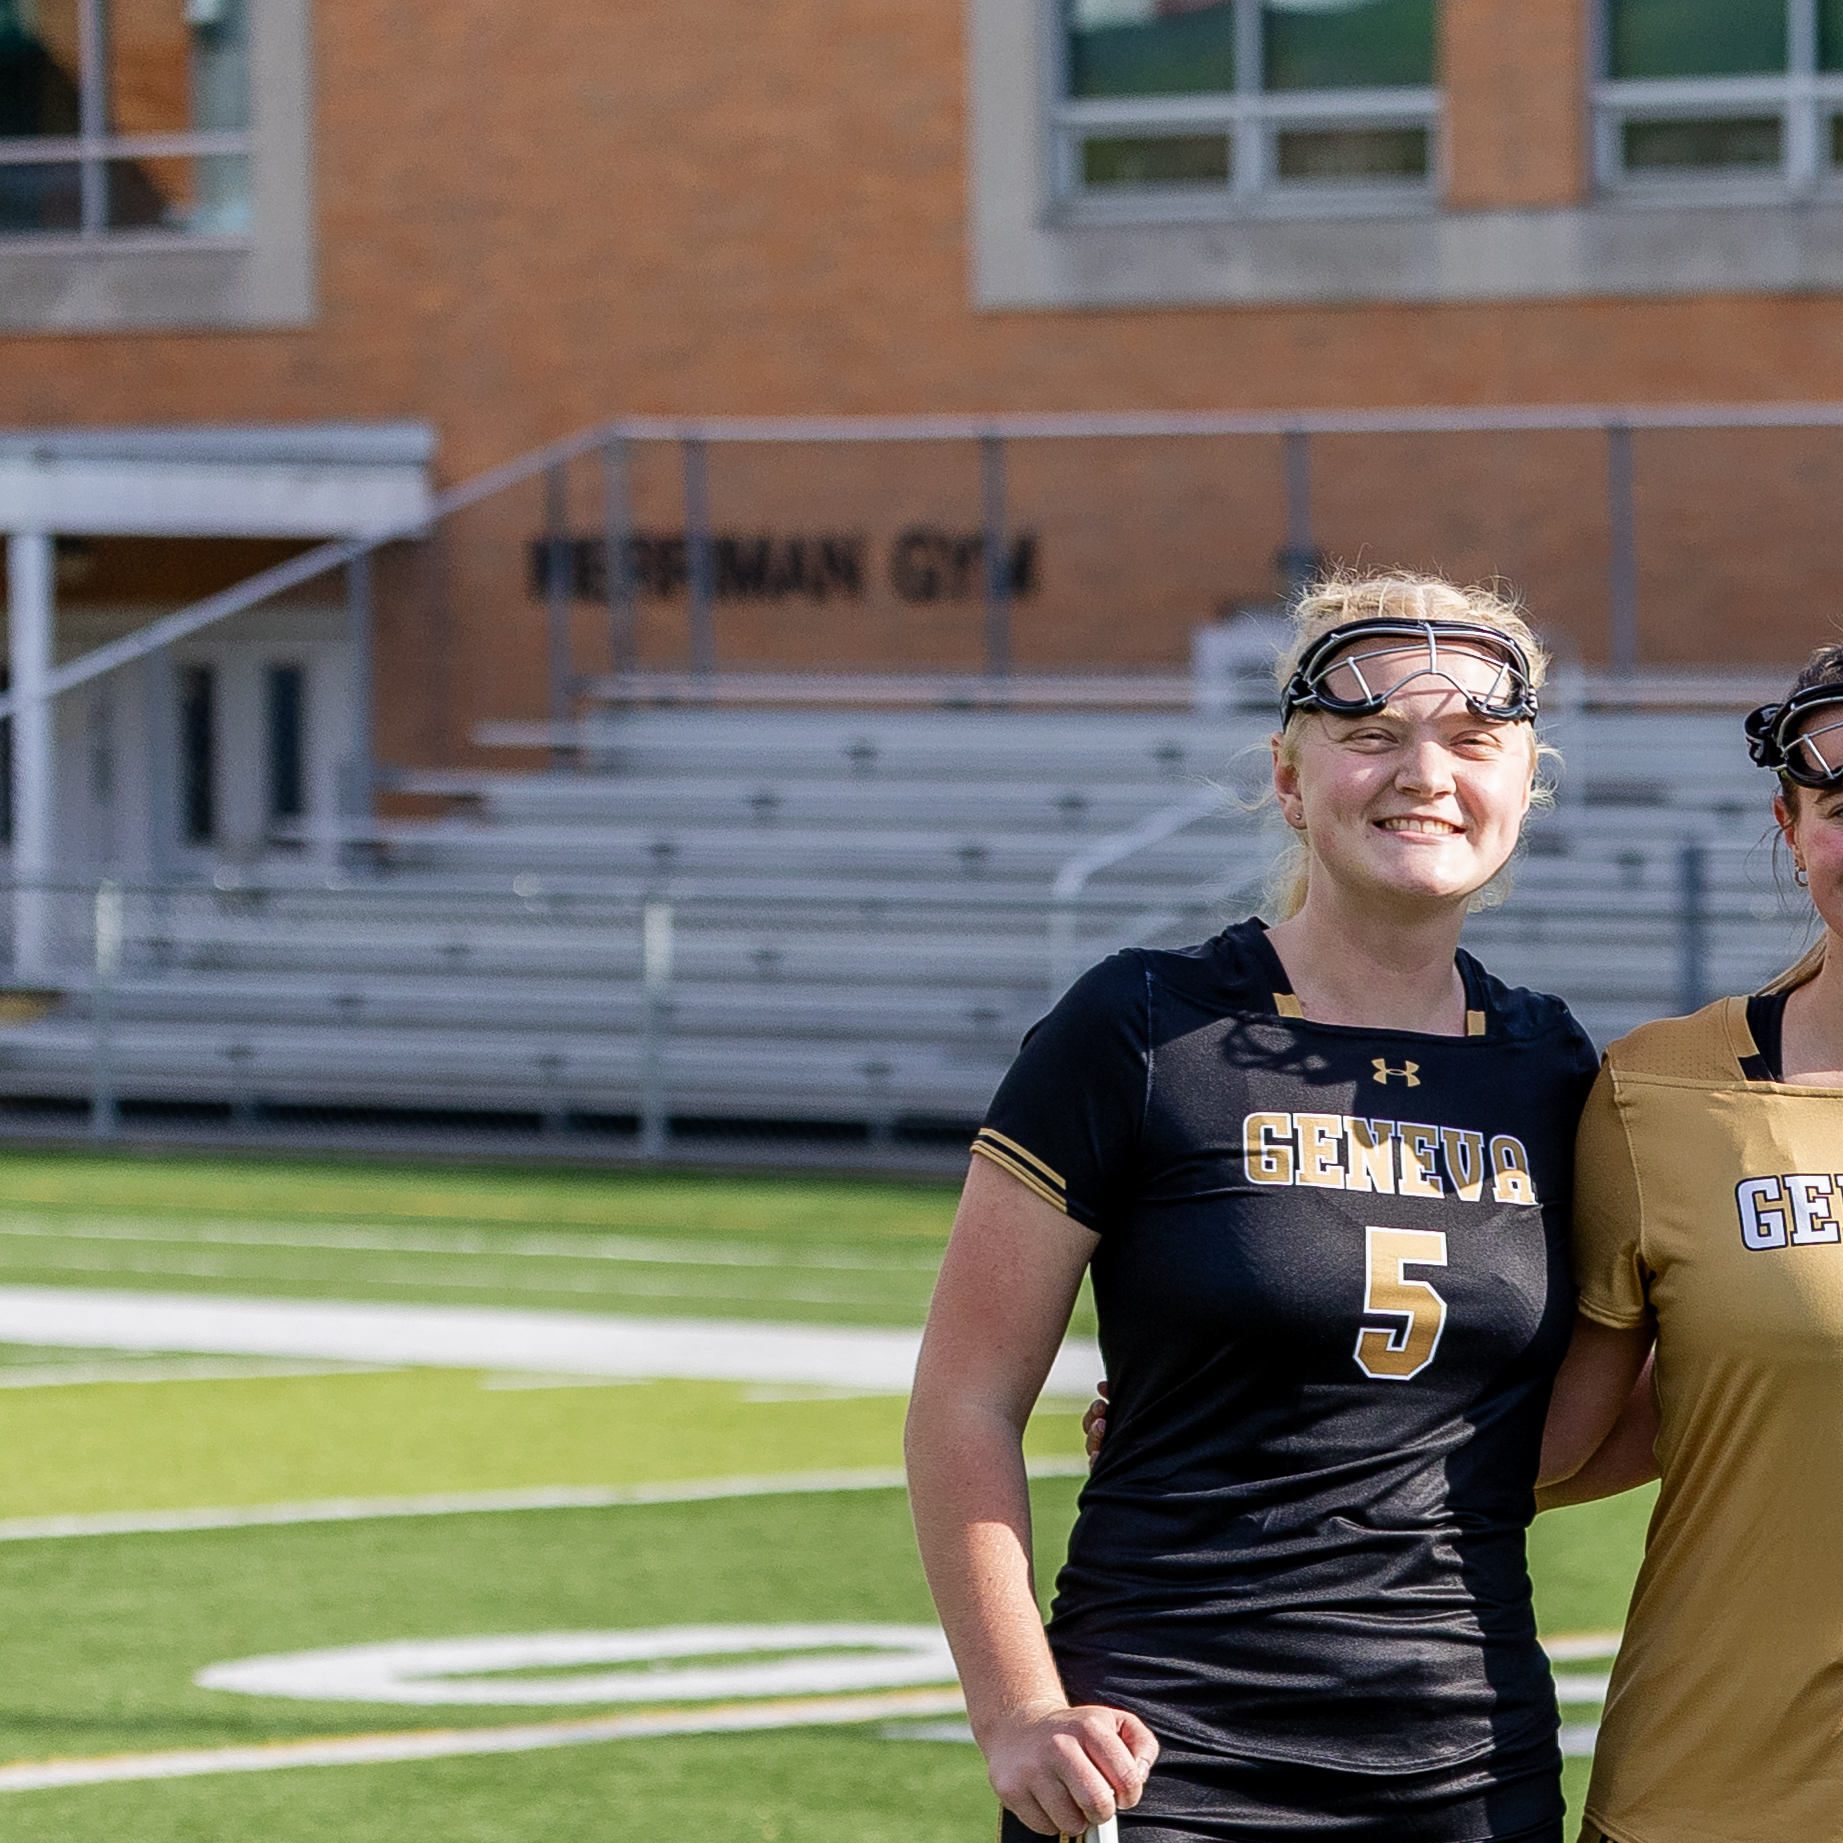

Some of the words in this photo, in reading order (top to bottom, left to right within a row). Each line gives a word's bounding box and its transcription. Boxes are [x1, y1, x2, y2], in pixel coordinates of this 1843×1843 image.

[527, 536, 864, 600] MERMAN
[1243, 1111, 1540, 1205] GENEVA
[1353, 1225, 1447, 1381] 5
